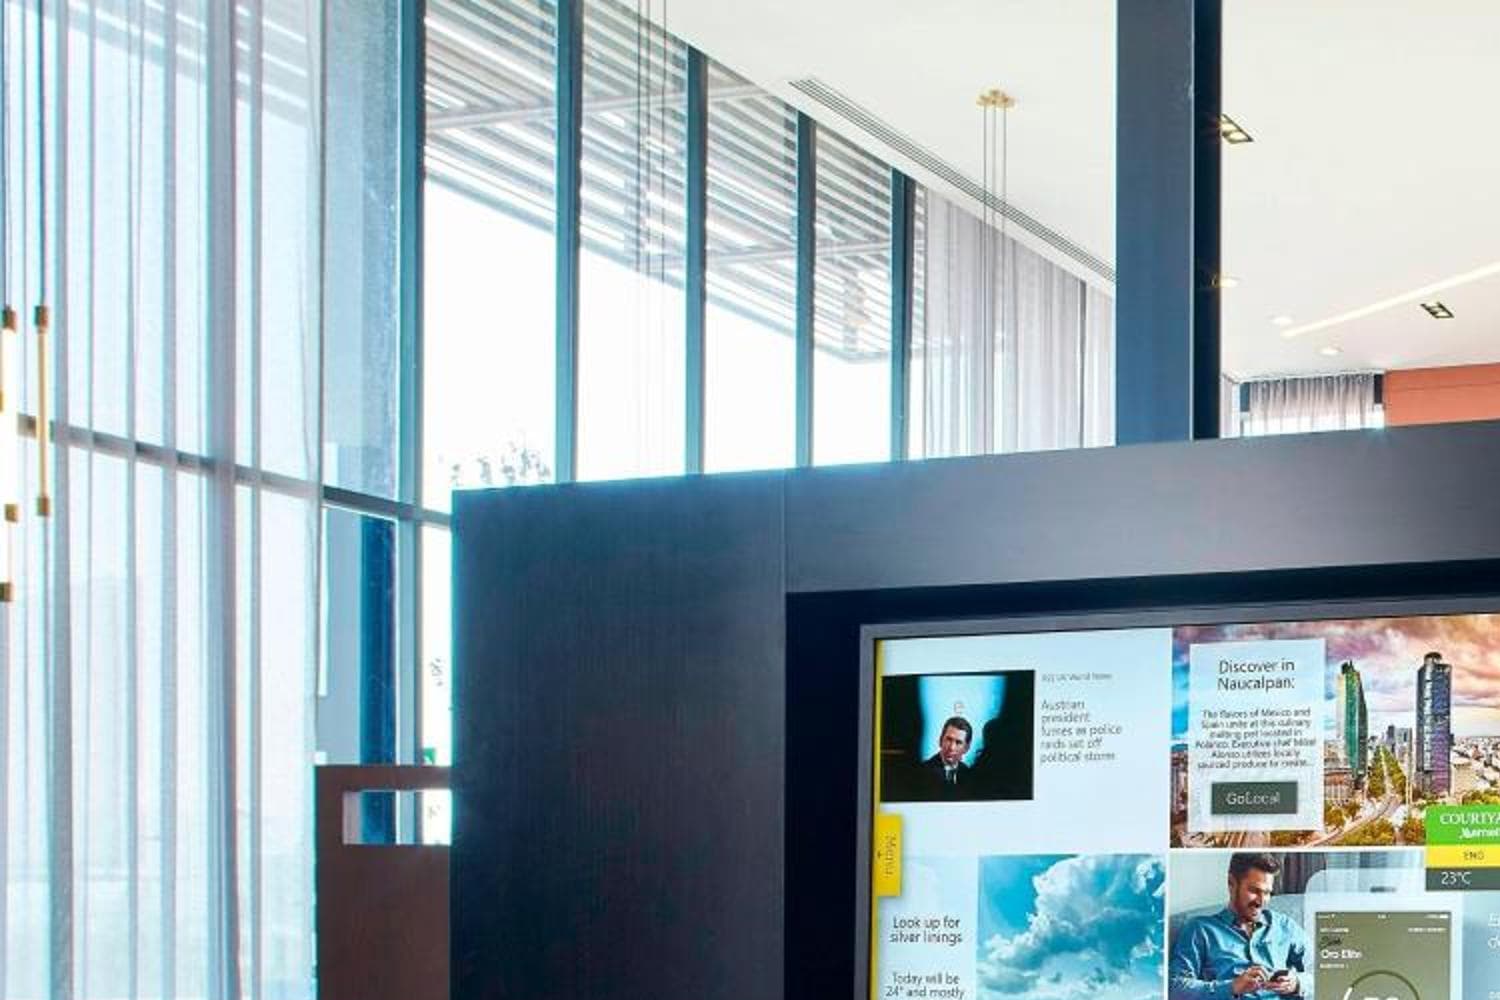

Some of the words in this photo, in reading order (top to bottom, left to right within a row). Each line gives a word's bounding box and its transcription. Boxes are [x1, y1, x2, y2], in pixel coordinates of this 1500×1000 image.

[1219, 659, 1277, 675] Discover
[1281, 658, 1295, 671] in
[1217, 674, 1295, 694] Naucalpan:
[1089, 724, 1122, 737] police
[1225, 790, 1281, 806] GoLocal
[893, 916, 921, 930] Look
[924, 919, 941, 933] up
[943, 916, 961, 929] for
[889, 931, 921, 944] silver
[923, 930, 963, 947] linings
[893, 971, 922, 986] Today
[925, 972, 943, 985] will
[945, 972, 961, 985] be
[906, 986, 927, 998] and
[929, 986, 964, 1000] mostly
